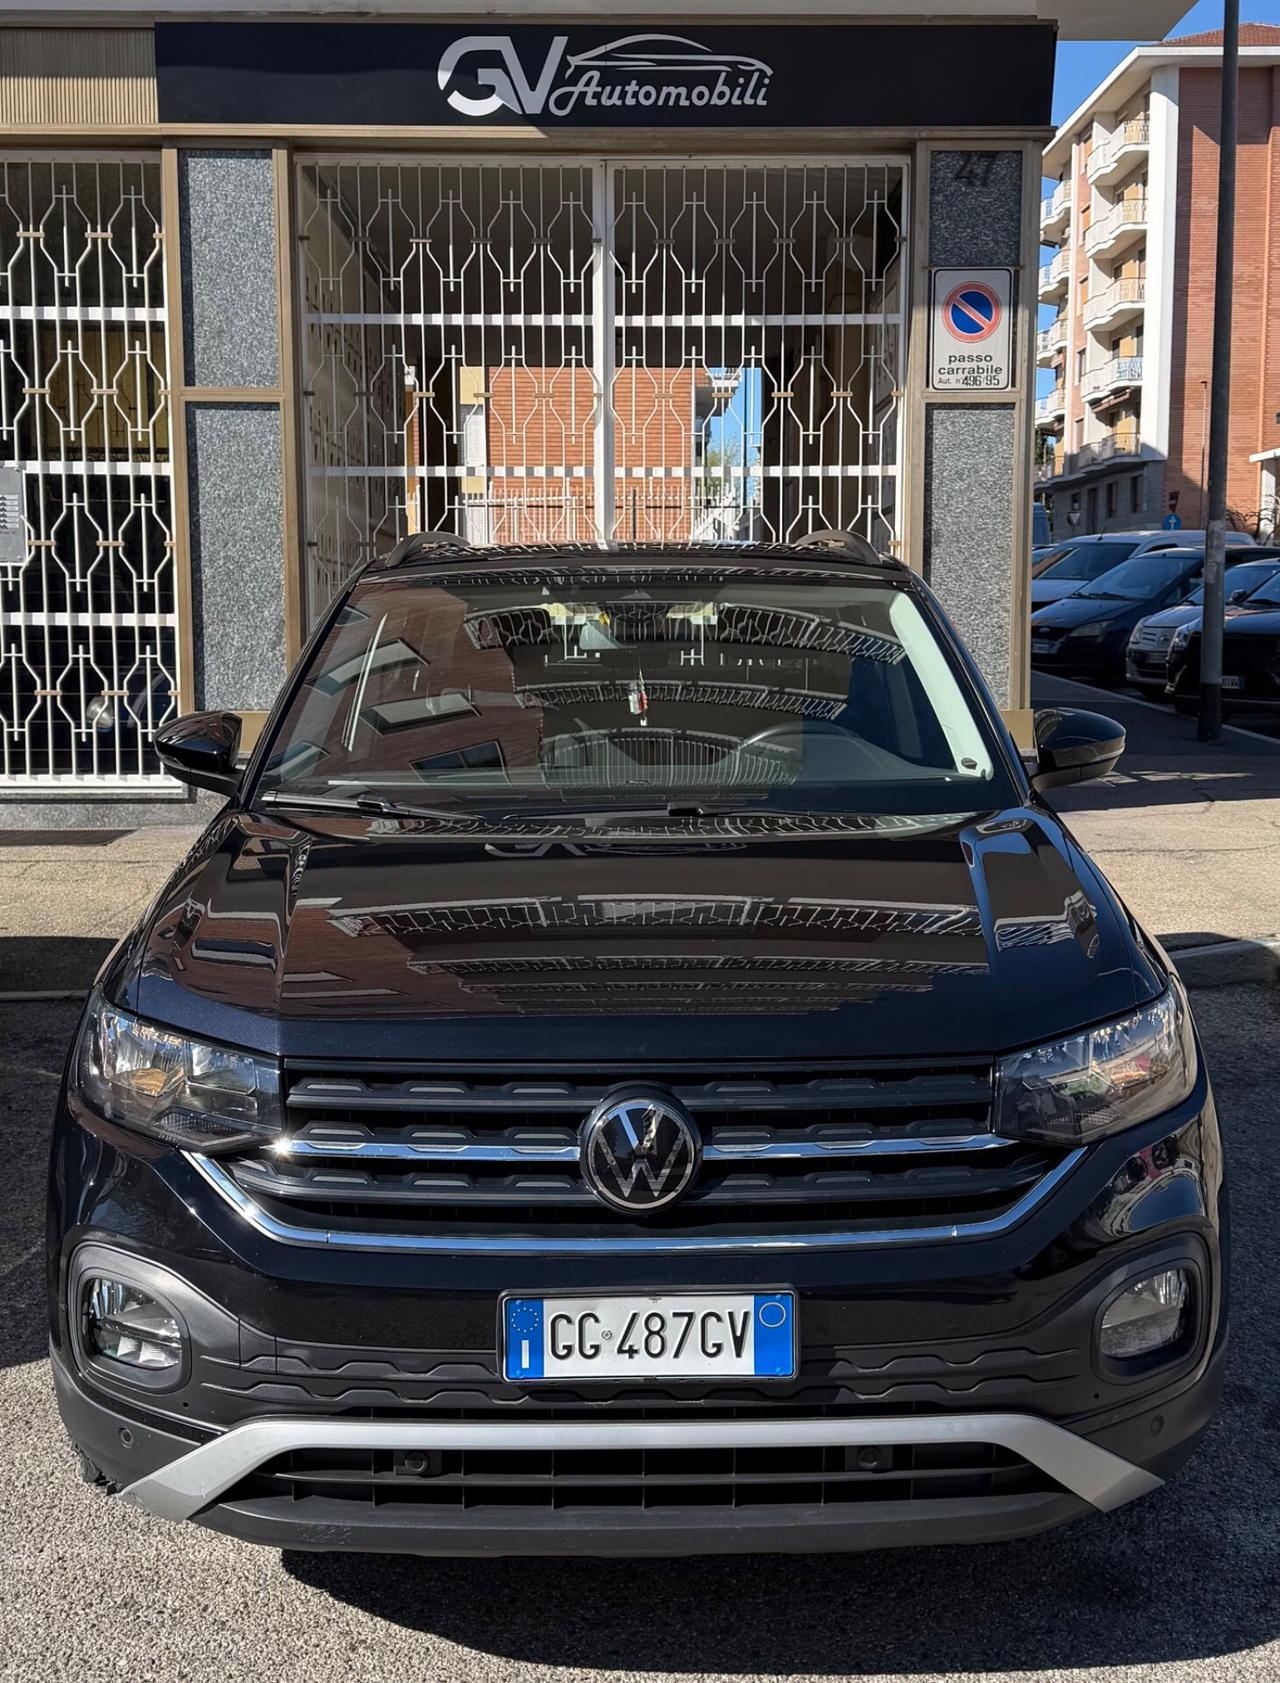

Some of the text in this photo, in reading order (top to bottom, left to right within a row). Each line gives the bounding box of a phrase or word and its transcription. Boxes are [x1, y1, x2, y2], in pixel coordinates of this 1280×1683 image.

[437, 36, 770, 116] GV Automobili
[948, 354, 993, 365] passo
[938, 365, 1003, 375] carrabile
[938, 377, 952, 385] Aut.
[549, 1310, 750, 1360] GG 487GV
